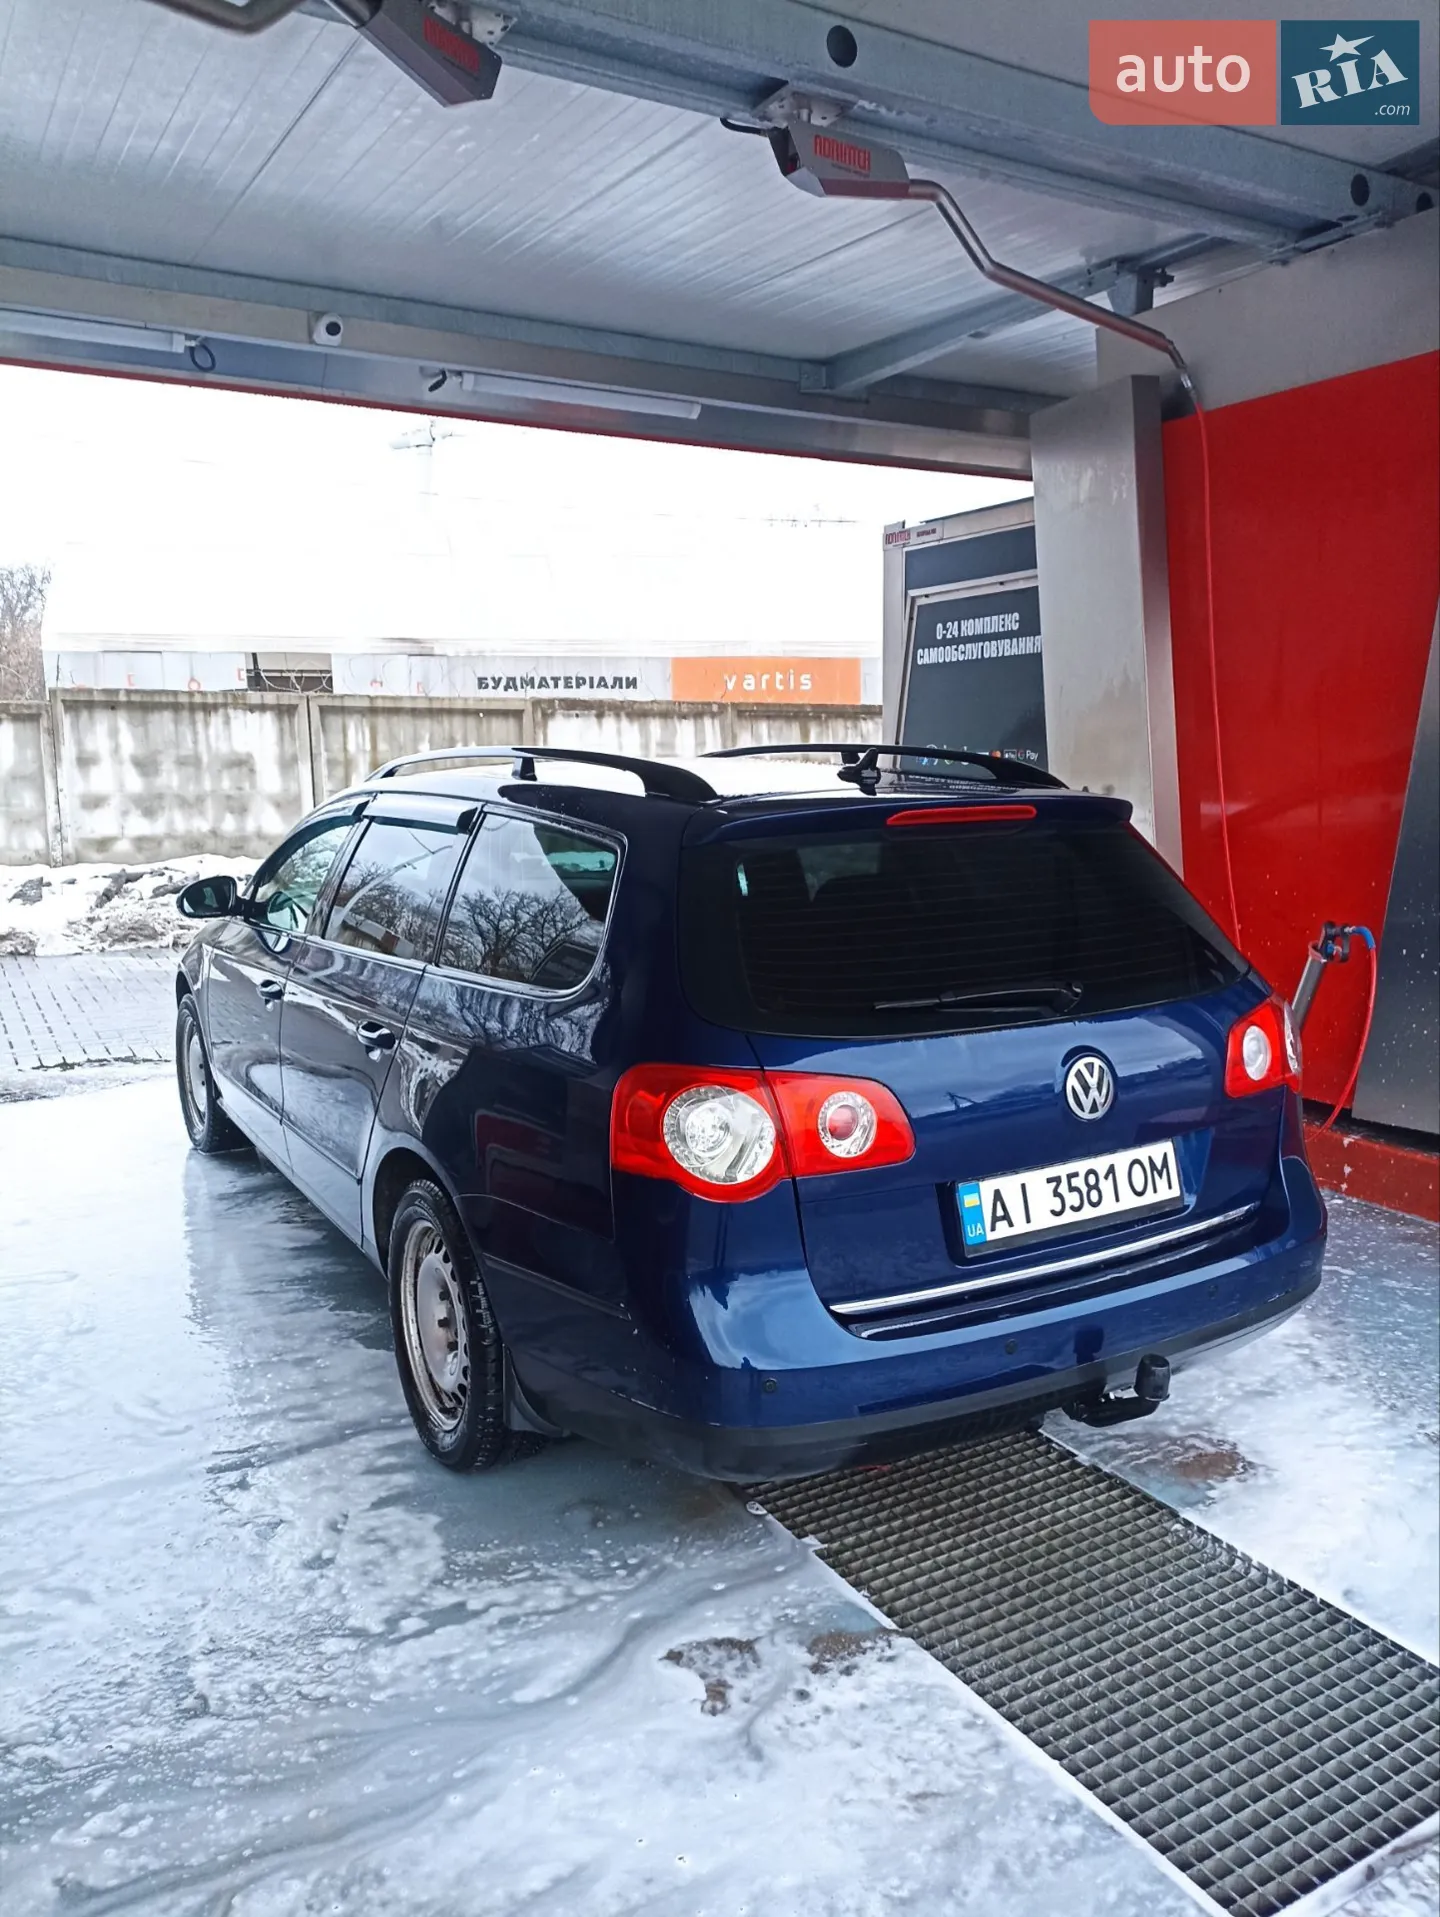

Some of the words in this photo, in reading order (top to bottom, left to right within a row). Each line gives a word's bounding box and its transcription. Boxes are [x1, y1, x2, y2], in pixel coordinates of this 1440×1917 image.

[936, 621, 959, 640] 0-24
[960, 612, 1020, 637] КОМПЛЕКС
[916, 635, 1042, 665] САМООБСЛУГОВУВАННЯ
[477, 675, 639, 691] БУДМАТЕРІАЛИ
[724, 669, 814, 692] vartis
[990, 1182, 1032, 1232] AI
[1046, 1162, 1121, 1218] 3581
[1127, 1151, 1173, 1198] OM
[966, 1223, 985, 1238] UA
